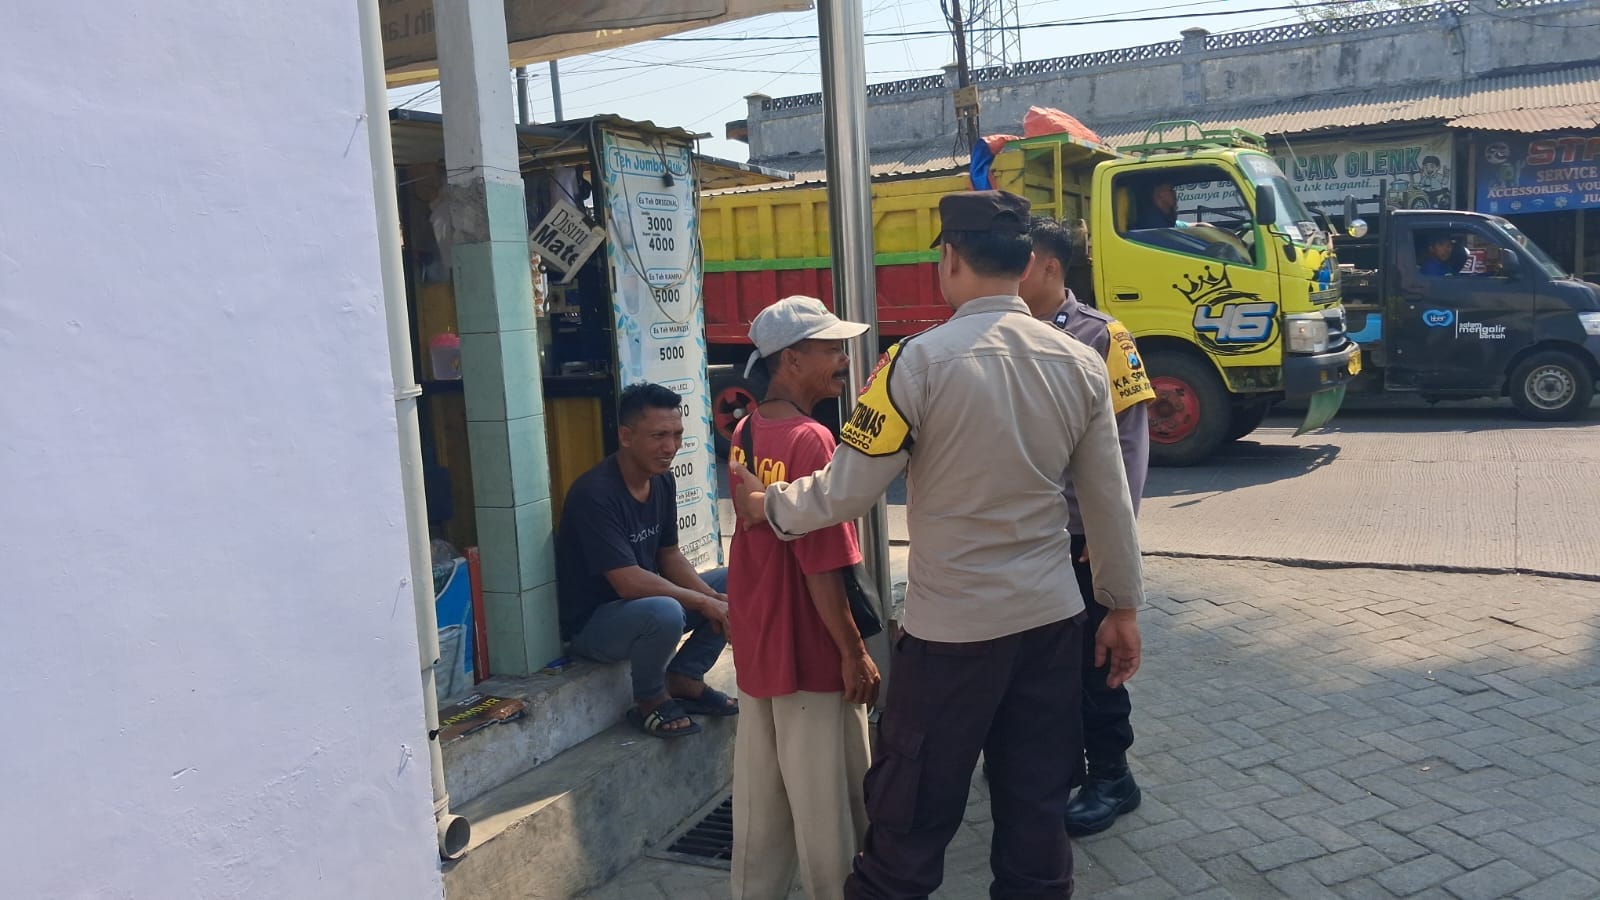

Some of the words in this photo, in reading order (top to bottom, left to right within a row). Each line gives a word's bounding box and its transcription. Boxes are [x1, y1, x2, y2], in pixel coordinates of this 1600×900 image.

[613, 152, 631, 169] Teh
[634, 155, 664, 173] Jumbo
[1536, 166, 1598, 182] SERVICE
[1177, 189, 1220, 201] Rasanya
[647, 216, 673, 231] 3000
[649, 237, 675, 252] 4000
[655, 288, 680, 303] 5000
[1192, 302, 1278, 344] 46
[1459, 324, 1506, 335] mengalir
[660, 345, 685, 361] 5000
[1113, 375, 1130, 389] KA
